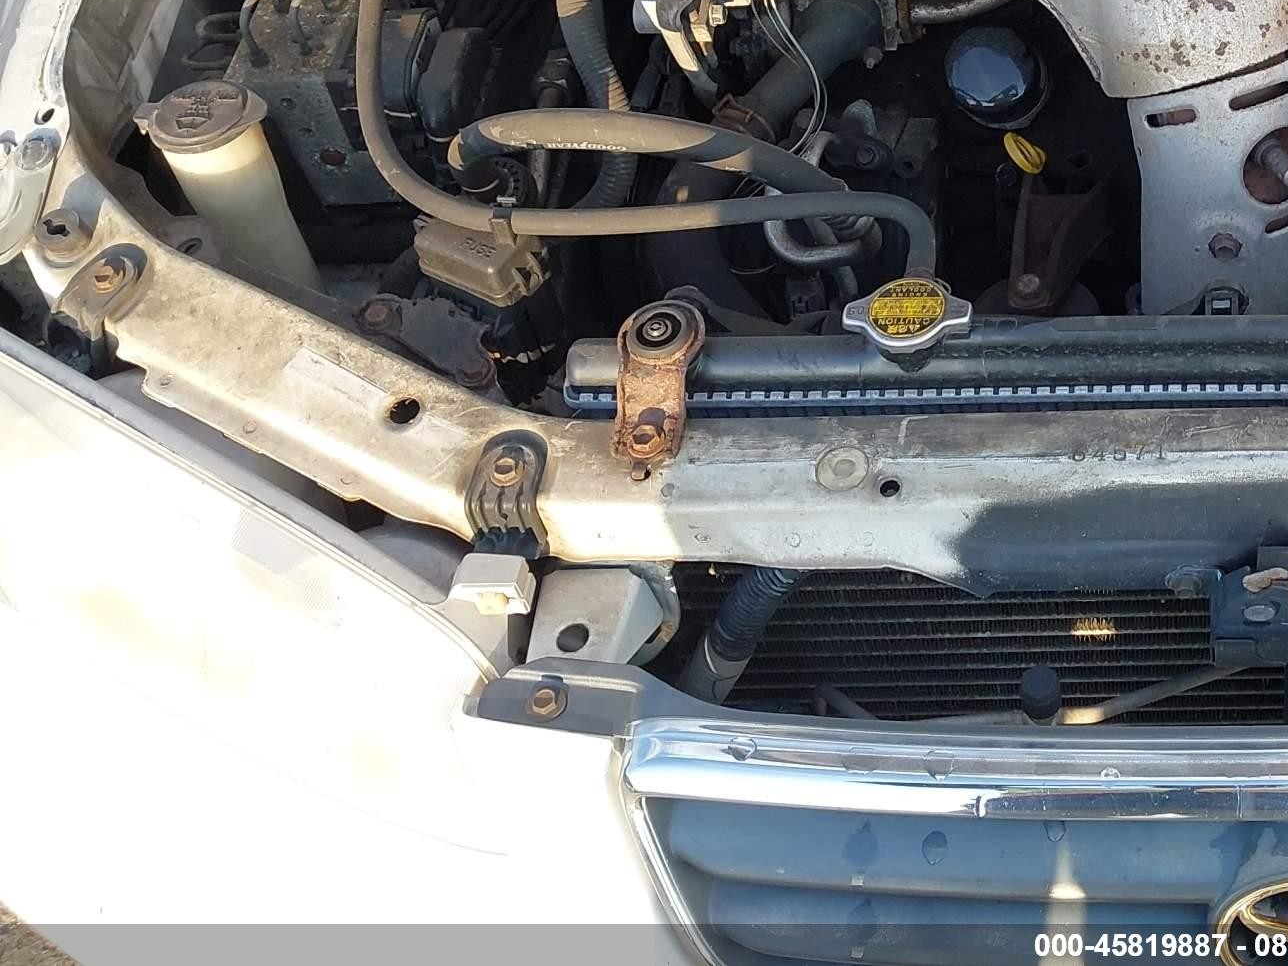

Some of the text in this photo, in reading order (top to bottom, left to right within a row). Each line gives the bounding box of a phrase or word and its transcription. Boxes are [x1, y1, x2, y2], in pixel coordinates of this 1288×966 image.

[546, 141, 627, 152] GOODYEAR
[460, 237, 497, 259] FUSE
[878, 317, 930, 325] CAUTION
